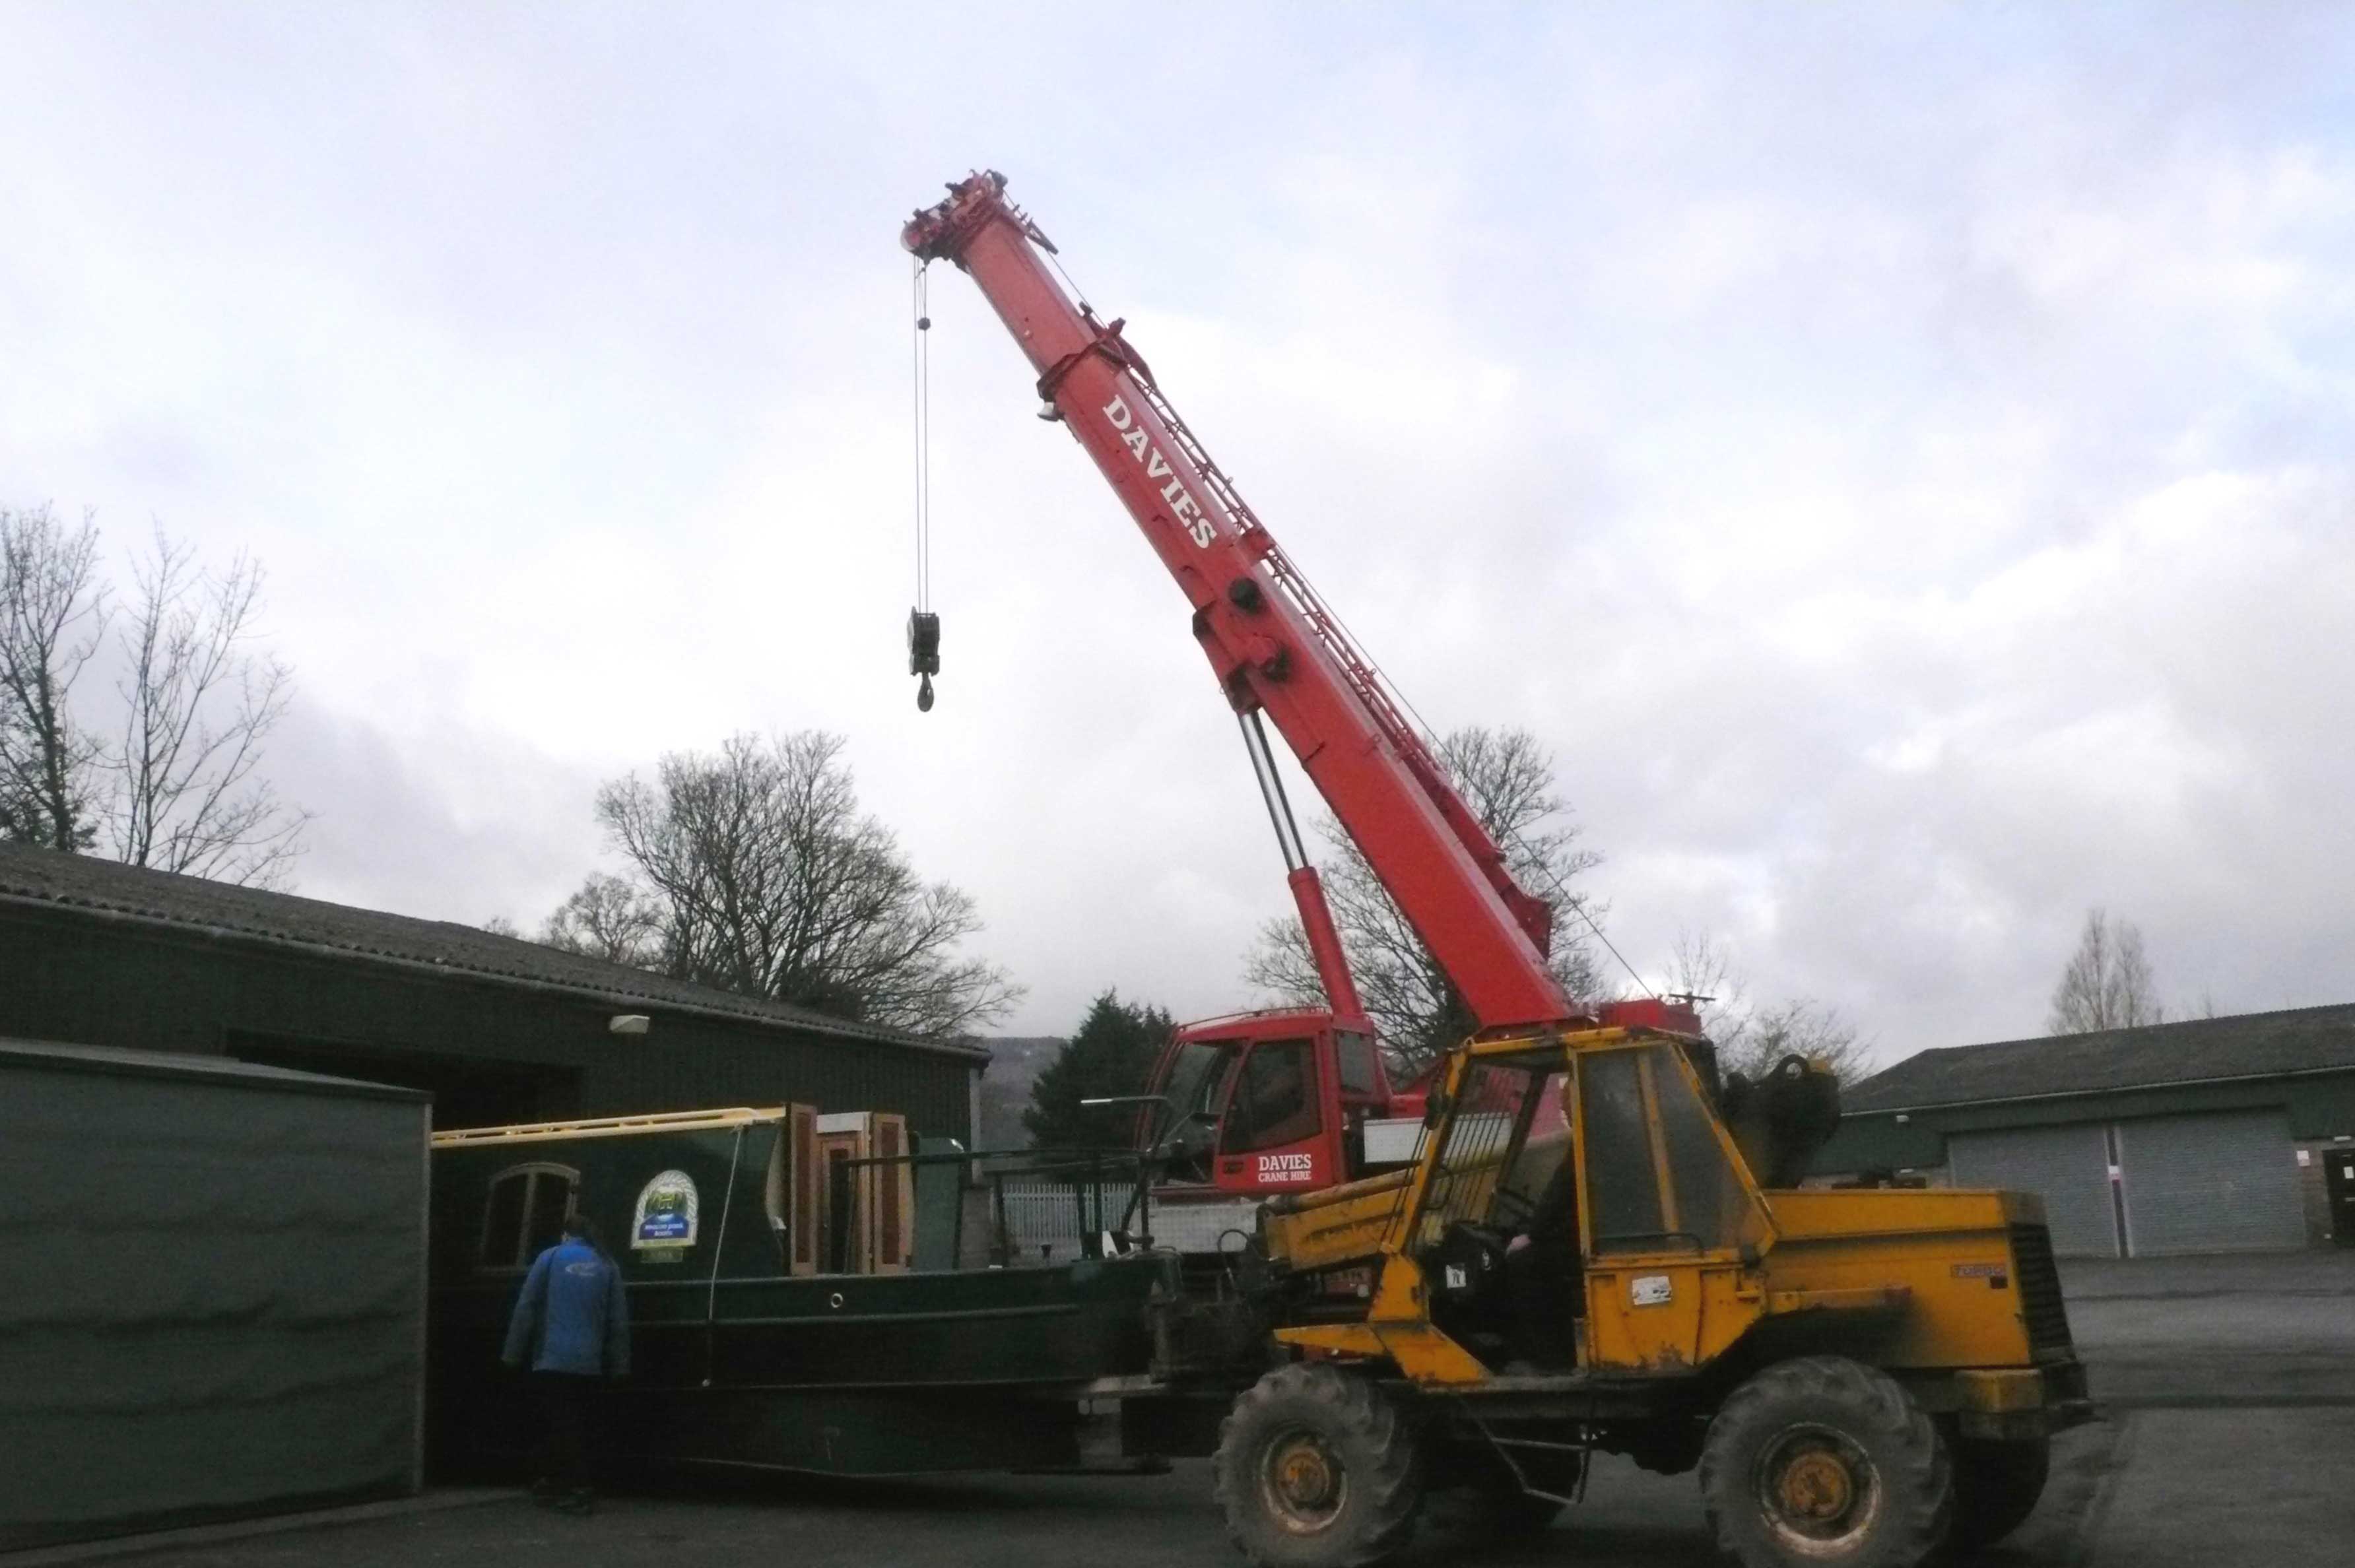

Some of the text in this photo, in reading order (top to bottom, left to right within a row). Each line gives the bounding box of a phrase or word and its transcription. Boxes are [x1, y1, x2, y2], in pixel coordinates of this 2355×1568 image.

[1102, 394, 1217, 548] DAVIES
[1258, 1154, 1312, 1171] DAVIES
[1258, 1170, 1311, 1183] CRANE HIRE
